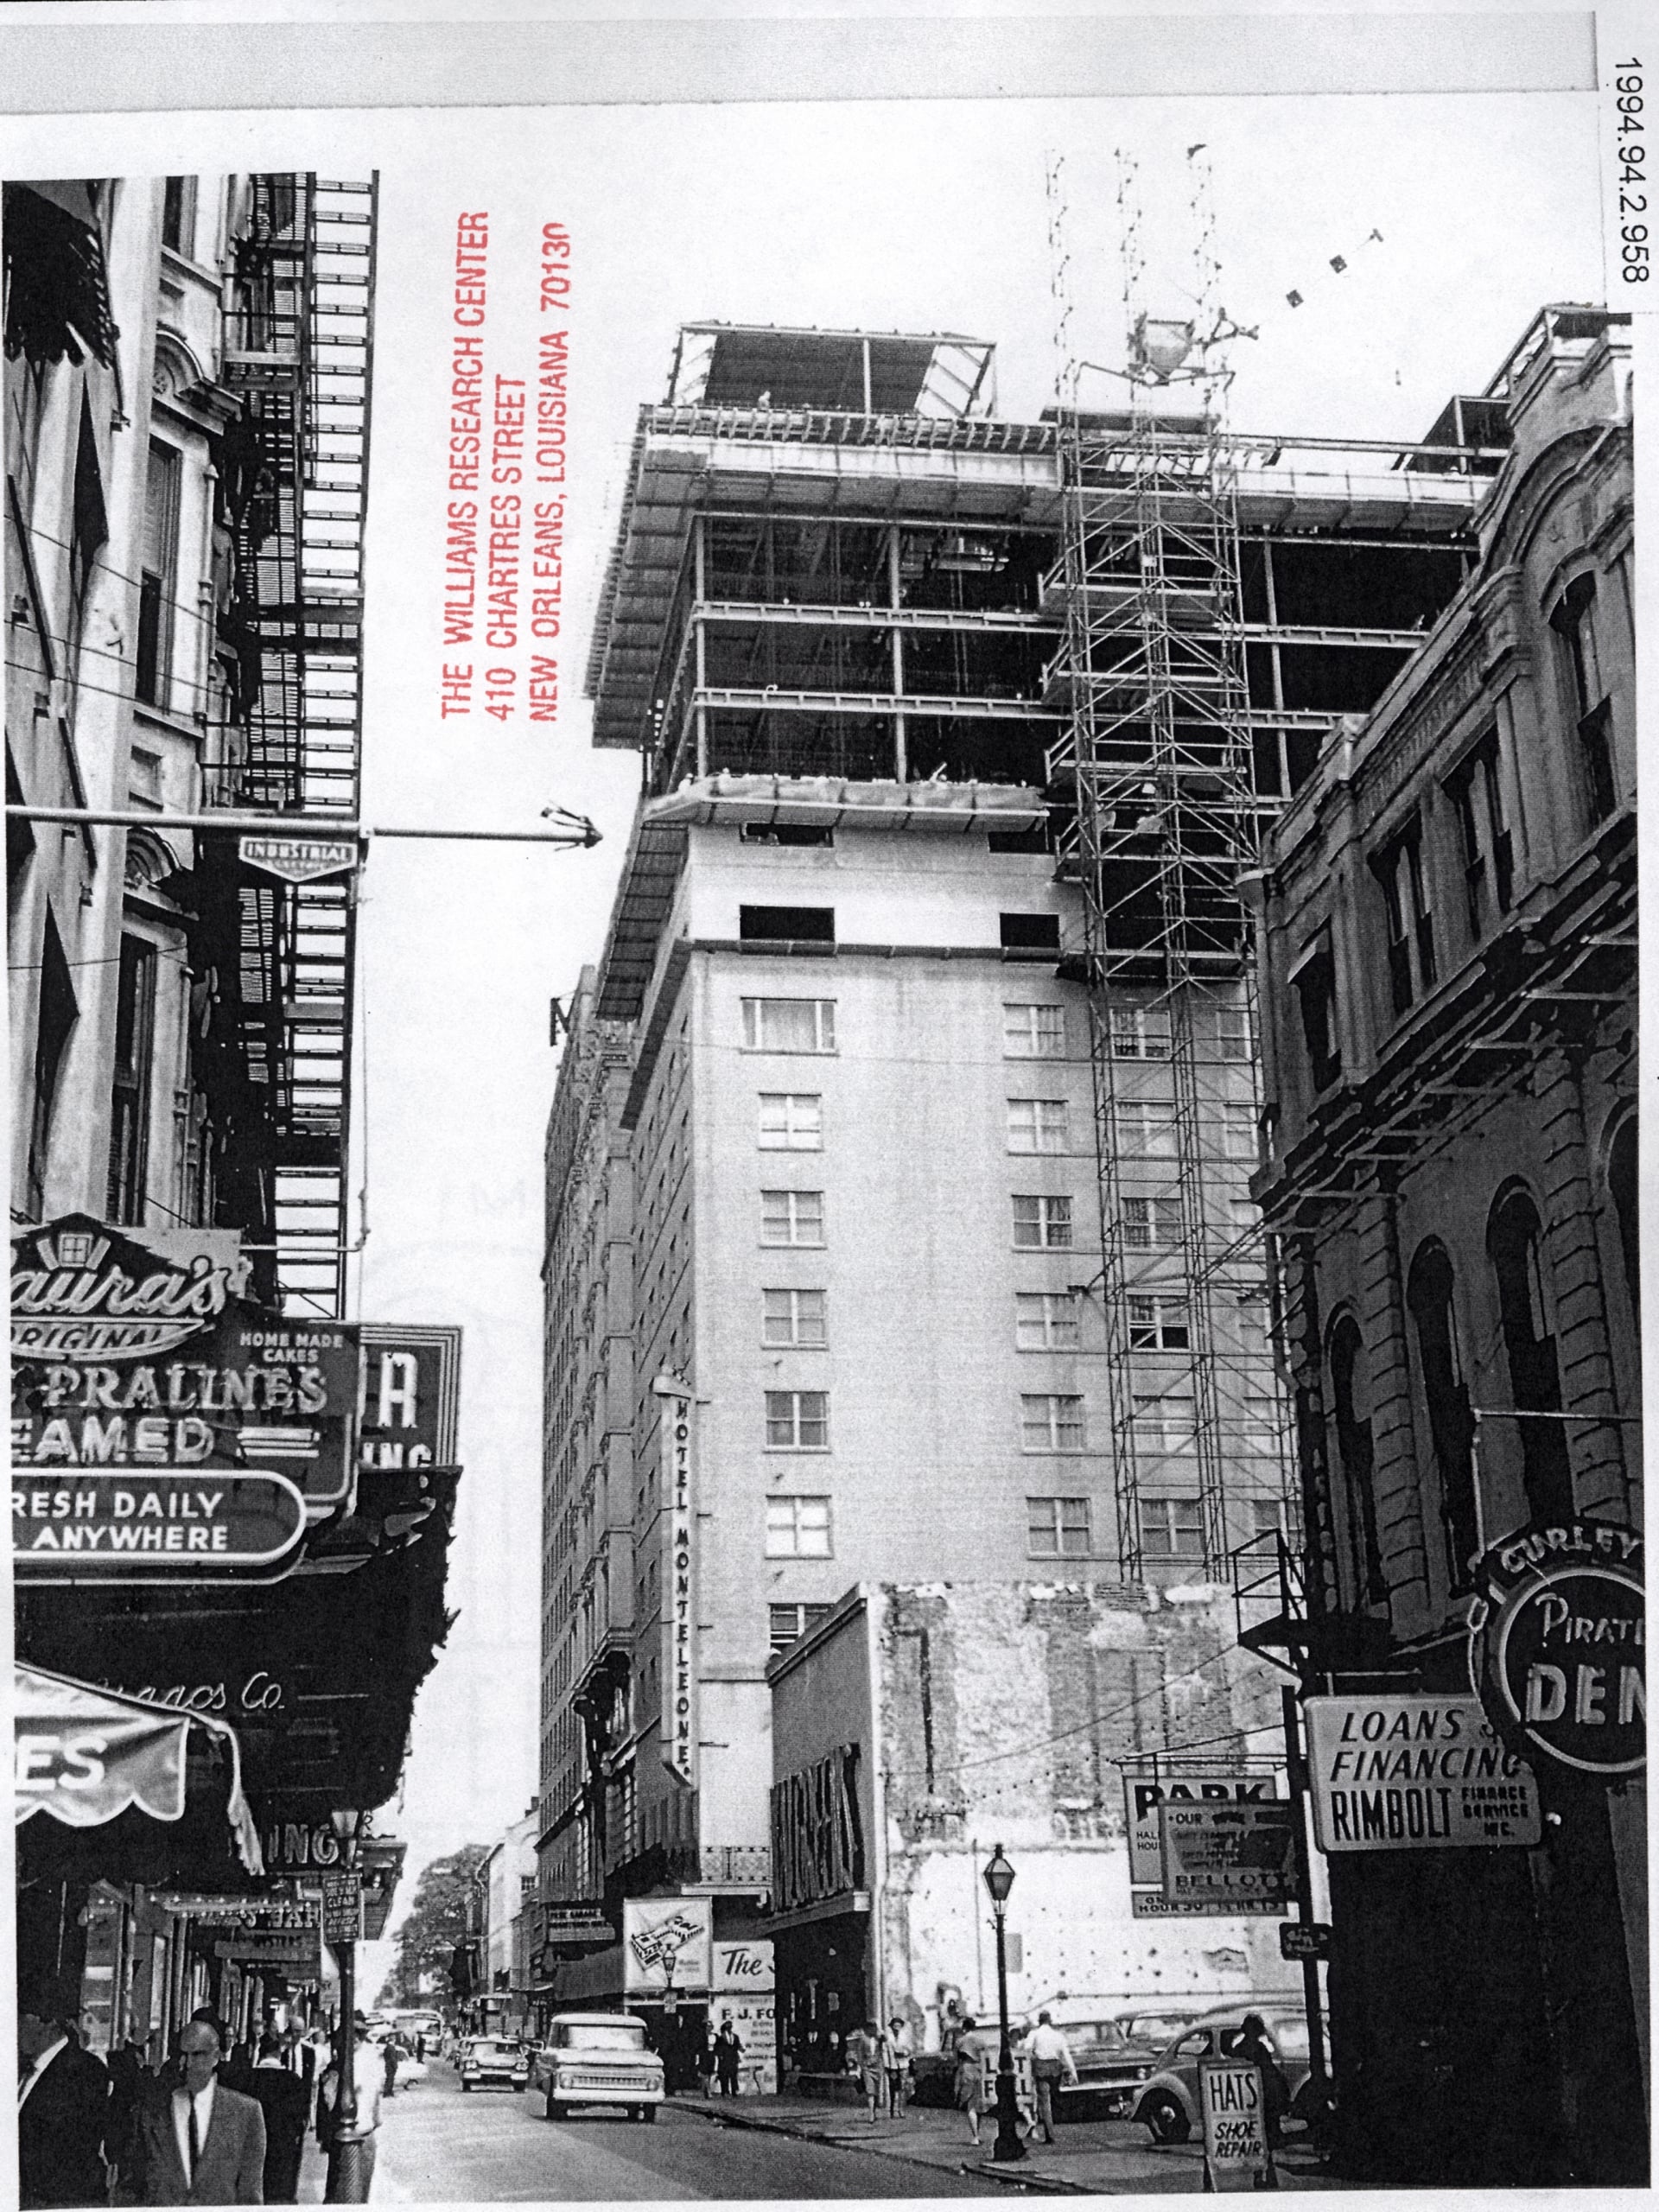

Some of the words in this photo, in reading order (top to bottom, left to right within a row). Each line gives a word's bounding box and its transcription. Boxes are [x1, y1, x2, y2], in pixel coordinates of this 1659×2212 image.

[246, 842, 346, 861] INDUSTRIAL
[10, 1250, 232, 1315] aura's
[240, 1332, 290, 1347] HOME
[296, 1333, 344, 1348] MADE
[263, 1348, 319, 1363] CAKES
[41, 1363, 327, 1413] PRALINES
[676, 1401, 689, 1510] HOTEL
[114, 1491, 224, 1518] DAILY
[32, 1525, 228, 1551] ANYWHERE
[676, 1528, 690, 1764] MONTELEONE
[241, 1671, 285, 1709] Co.
[1340, 1709, 1465, 1743] LOANS
[1330, 1747, 1523, 1782] FINANCING
[1175, 1813, 1203, 1825] OUR
[1331, 1787, 1452, 1841] RIMBOLT
[1461, 1785, 1528, 1802] FINANCE
[1462, 1802, 1529, 1819] SERVICE
[721, 1948, 763, 1976] The
[985, 2056, 1027, 2074] LT
[1210, 2072, 1258, 2111] HATS
[1214, 2120, 1259, 2139] SHOE
[1215, 2140, 1262, 2158] REPAIR
